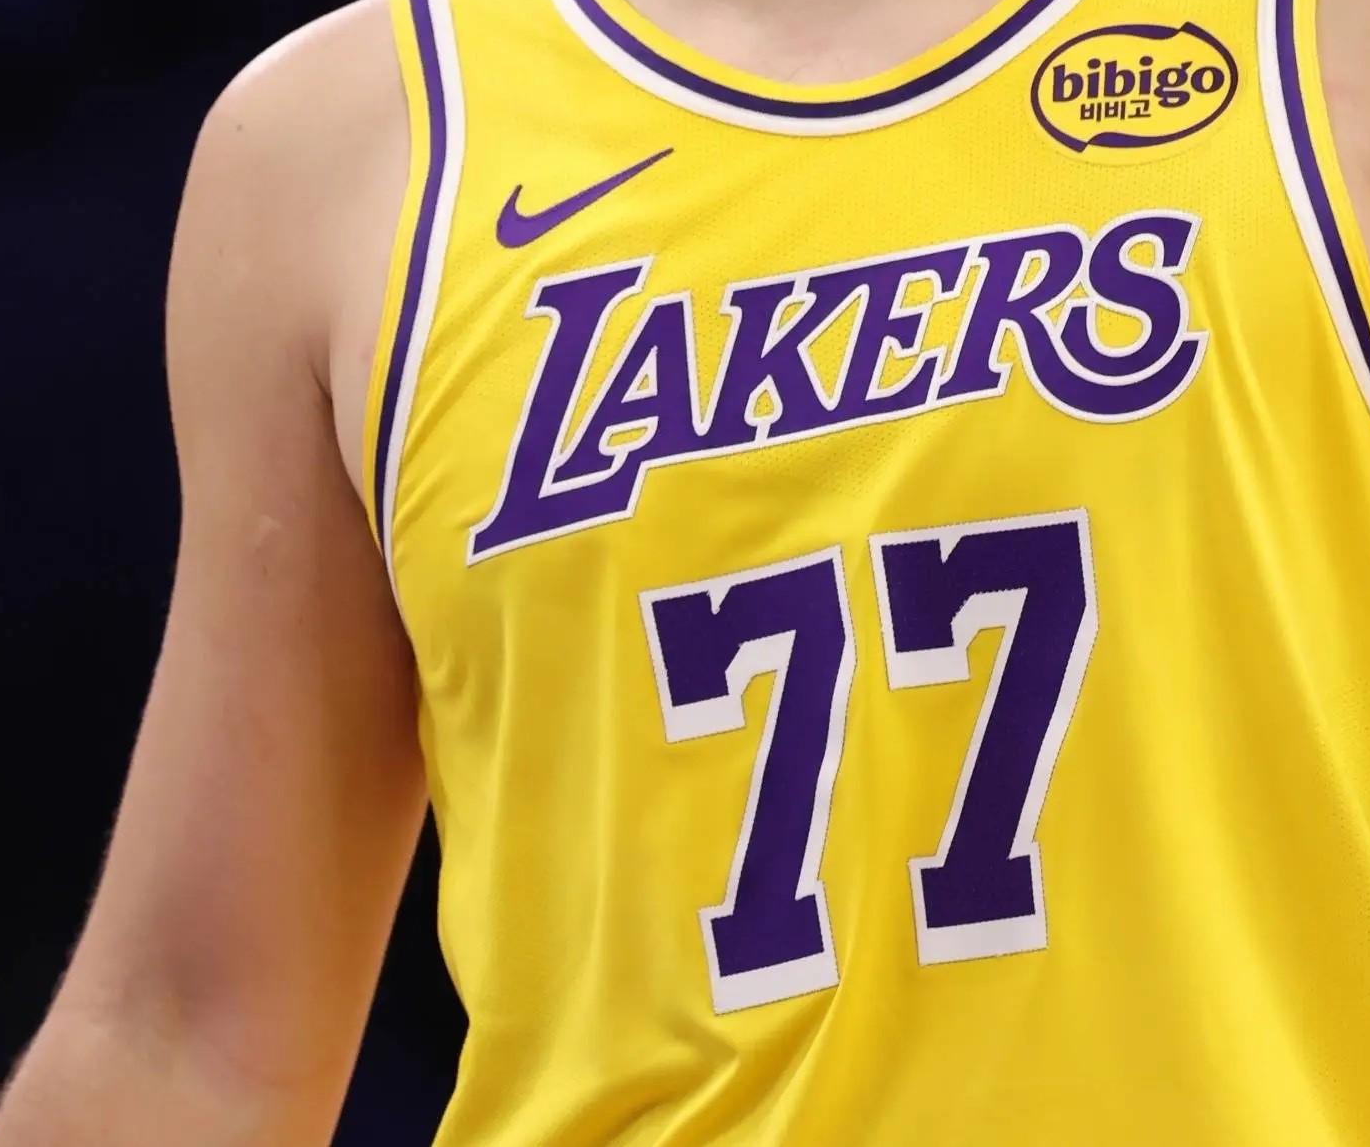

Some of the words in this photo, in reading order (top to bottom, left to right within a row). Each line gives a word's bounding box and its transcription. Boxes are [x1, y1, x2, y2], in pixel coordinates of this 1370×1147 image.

[1052, 55, 1226, 108] bibigo
[1079, 99, 1152, 123] 비비고
[466, 208, 1209, 566] LAKERS
[638, 507, 1099, 1016] 77
